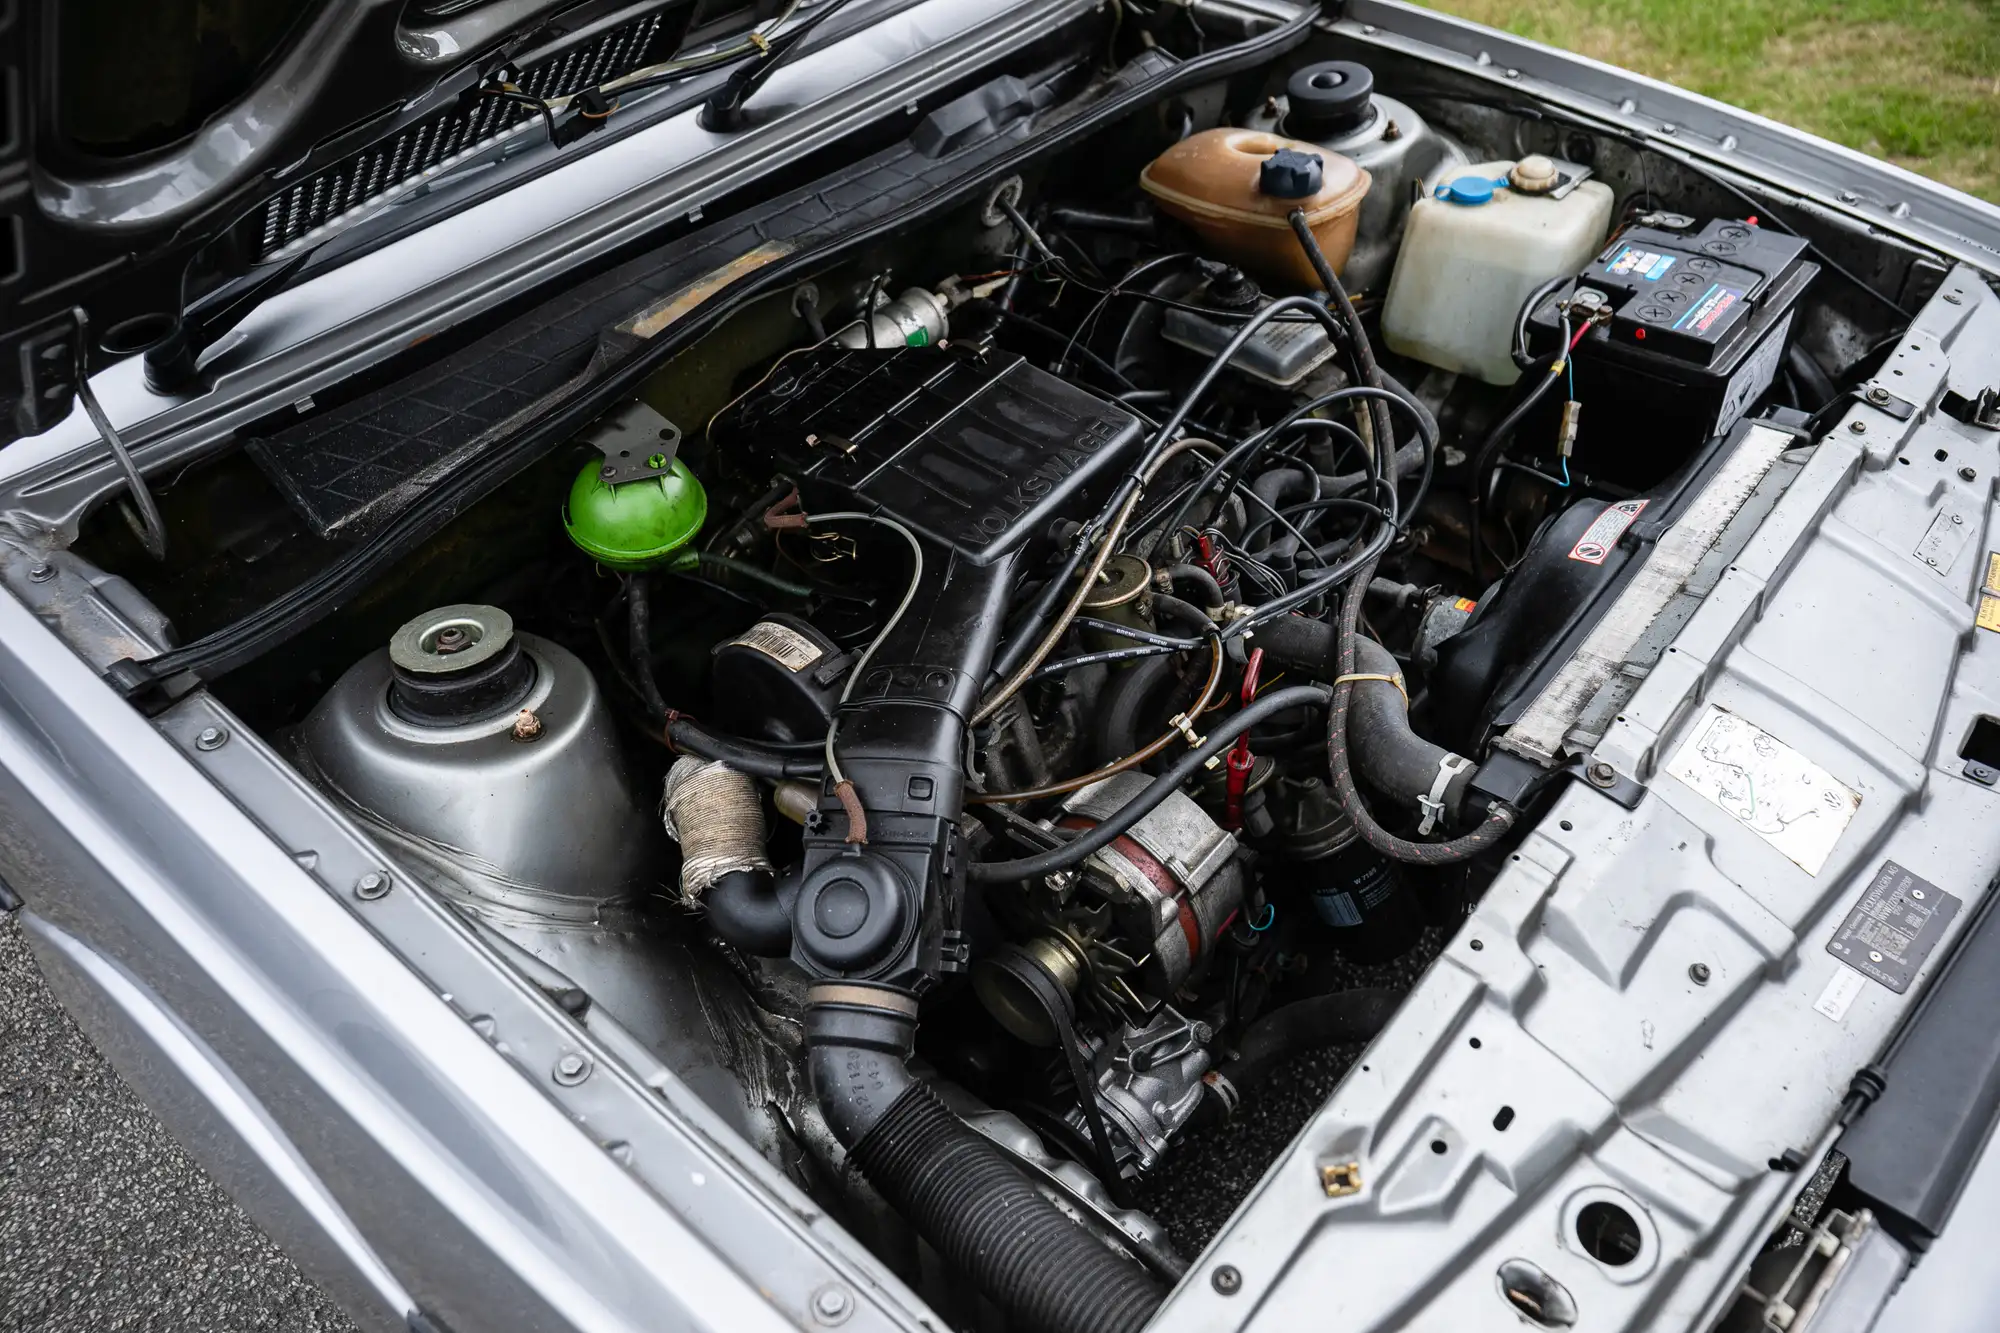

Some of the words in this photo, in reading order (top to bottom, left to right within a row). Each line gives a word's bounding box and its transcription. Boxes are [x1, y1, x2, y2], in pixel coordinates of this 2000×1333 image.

[959, 405, 1128, 545] VOLKSWAGEN
[1116, 628, 1136, 638] BREMI
[1149, 637, 1168, 646] BREMI
[1044, 662, 1063, 672] BREMI
[1076, 655, 1096, 664] BREMI
[1860, 875, 1893, 911] VOLKSWAGEN
[1887, 865, 1899, 877] AG
